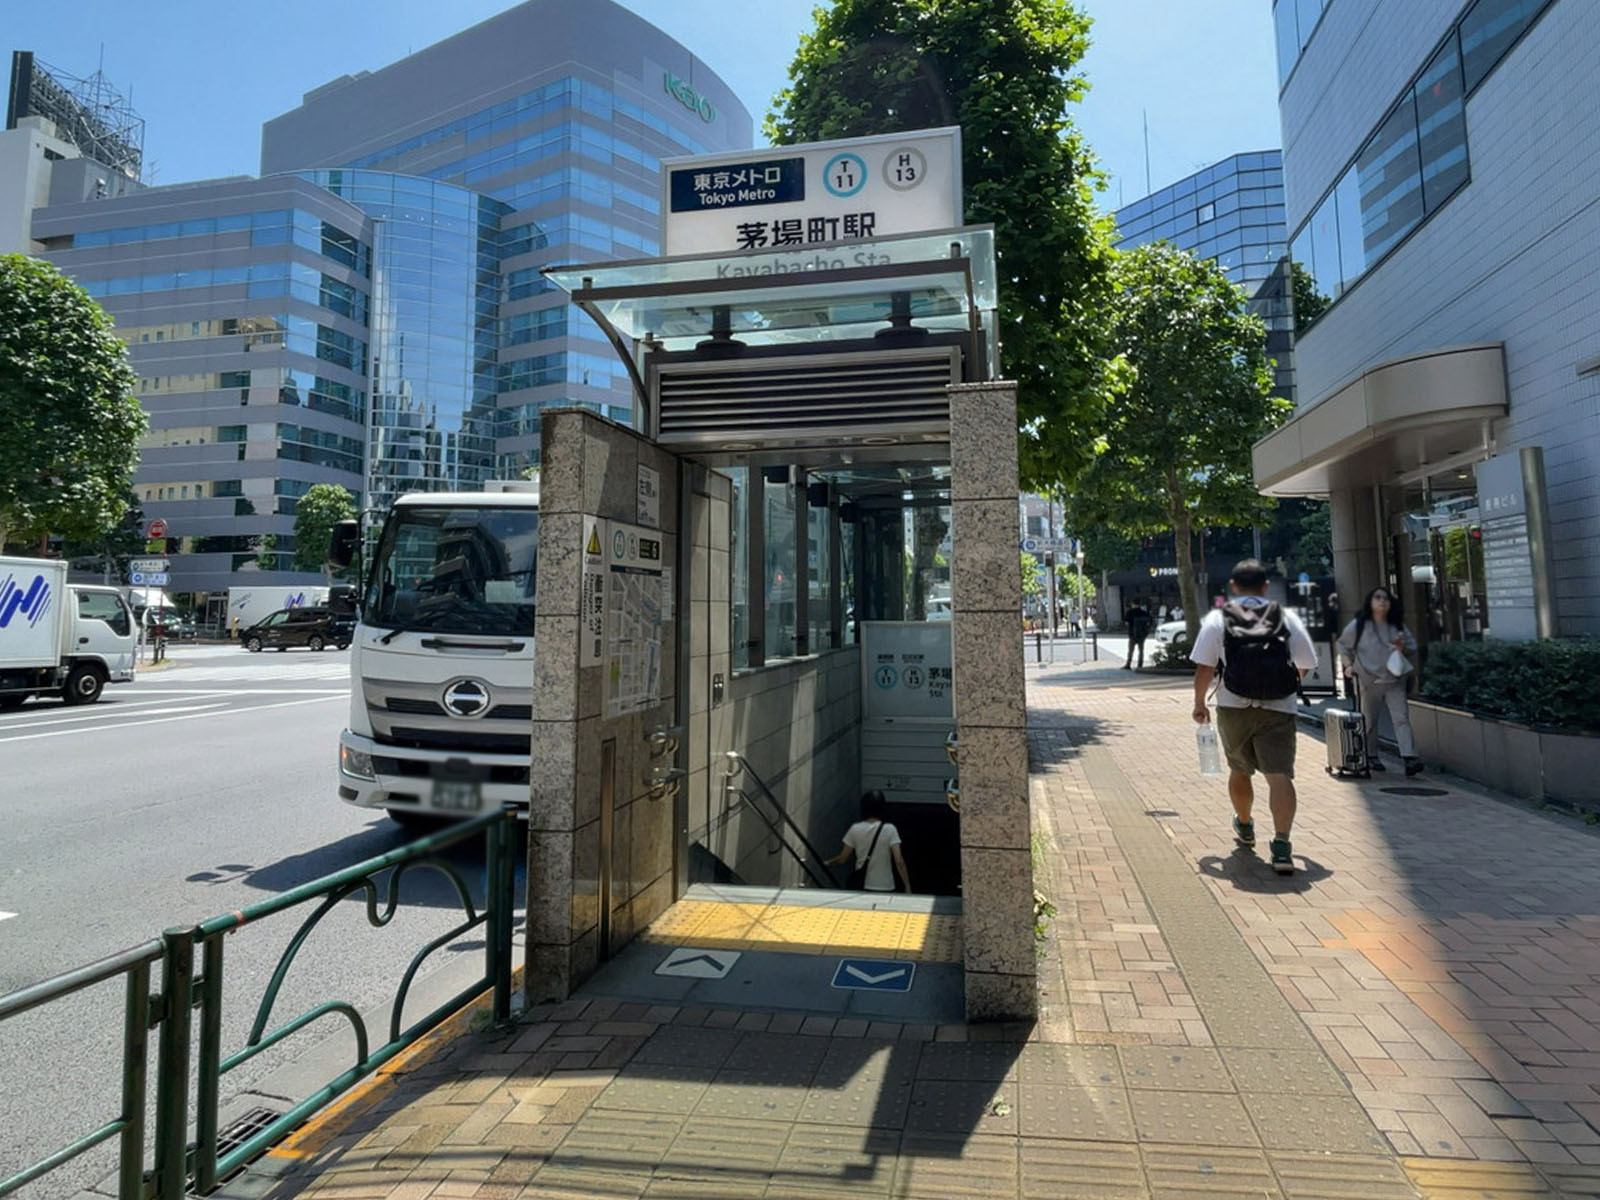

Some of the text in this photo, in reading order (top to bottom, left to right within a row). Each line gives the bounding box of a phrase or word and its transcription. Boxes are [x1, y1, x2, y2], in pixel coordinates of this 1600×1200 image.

[664, 70, 717, 123] Kao
[840, 161, 849, 172] T
[899, 155, 910, 167] H
[693, 167, 780, 190] 東京メトロ
[836, 175, 854, 189] 11
[895, 169, 915, 182] 13
[700, 188, 776, 206] Tokyo Metro
[736, 212, 875, 249] 茅場町駅
